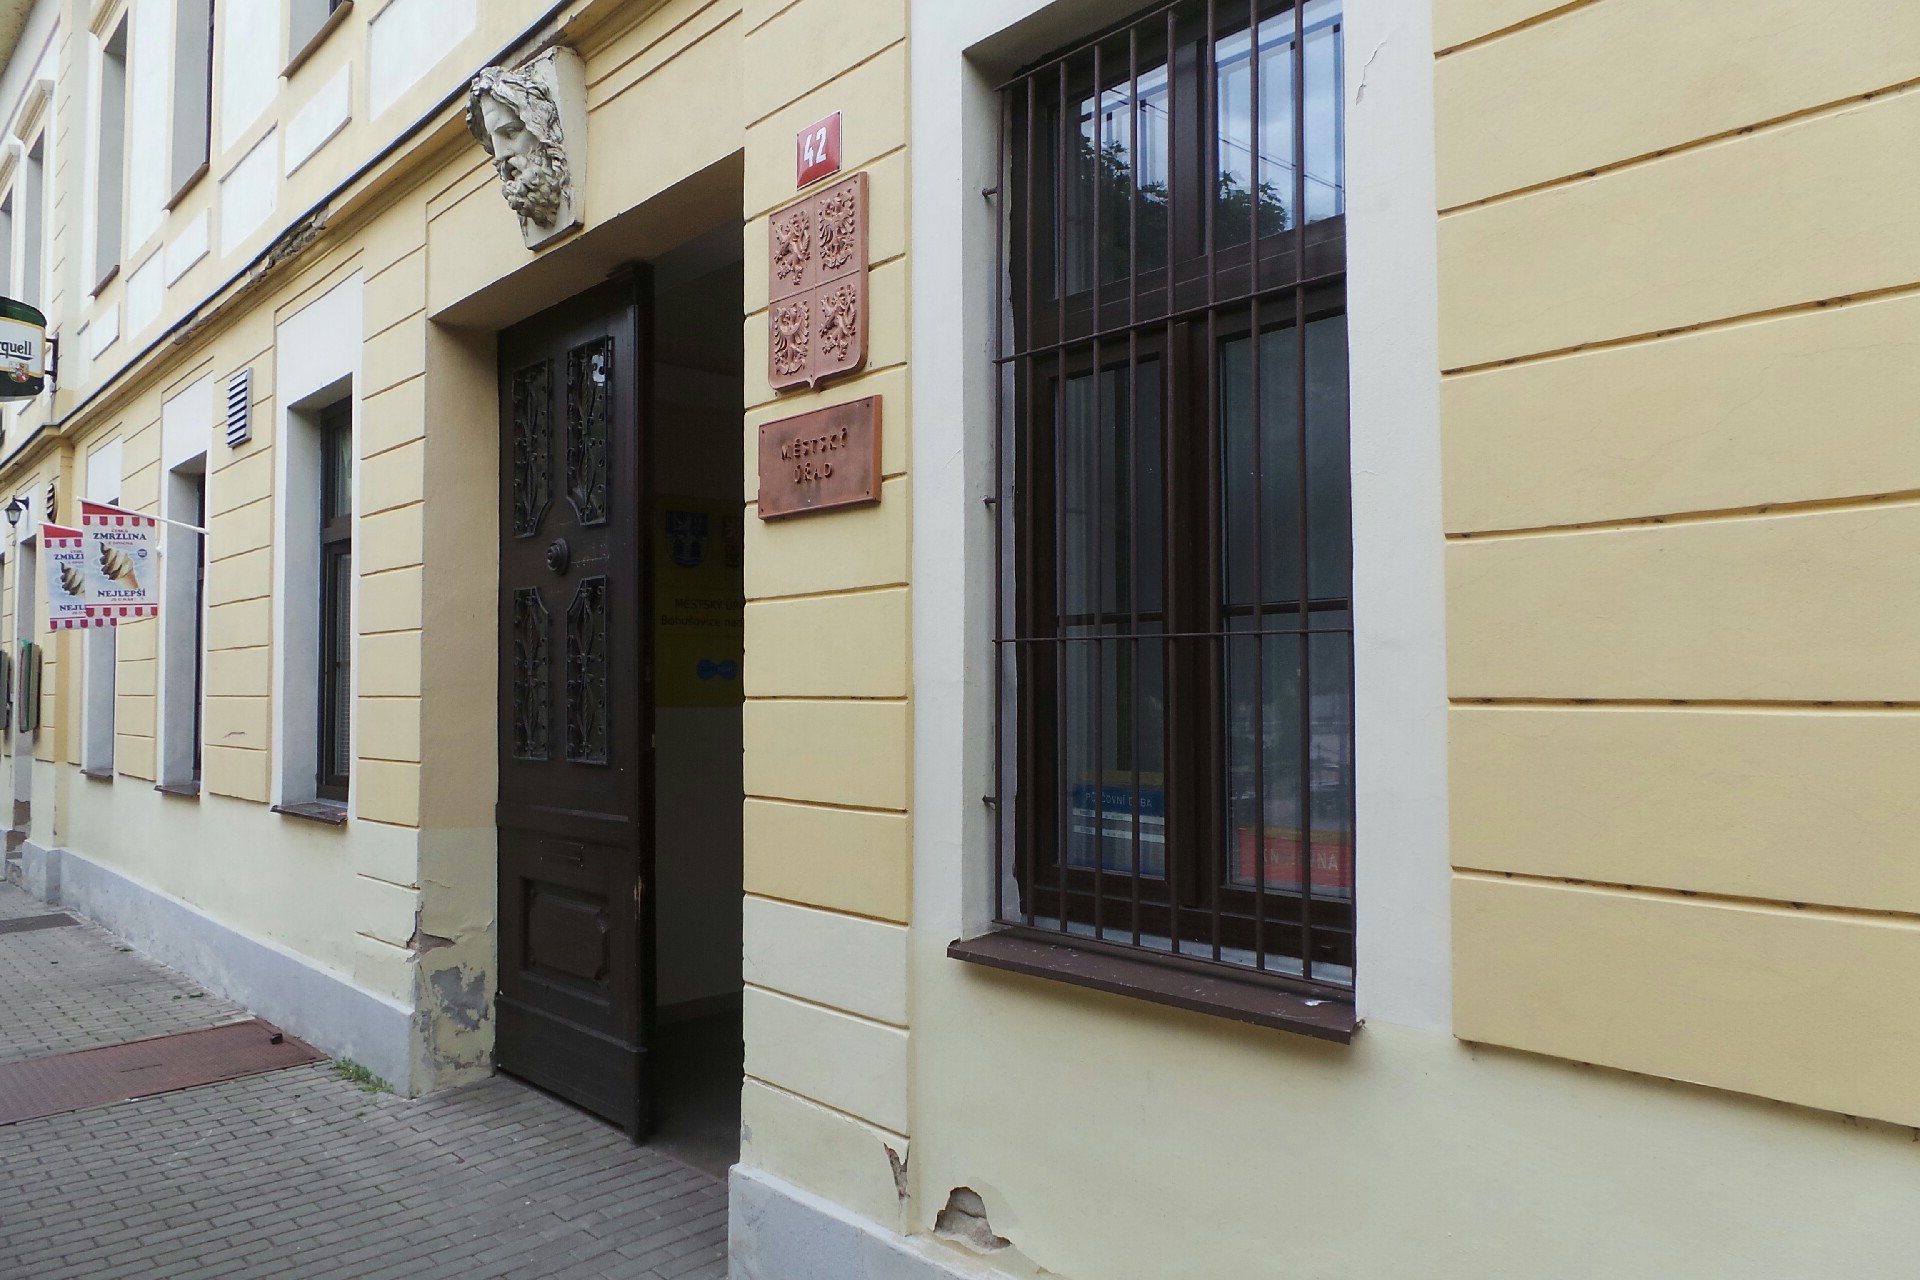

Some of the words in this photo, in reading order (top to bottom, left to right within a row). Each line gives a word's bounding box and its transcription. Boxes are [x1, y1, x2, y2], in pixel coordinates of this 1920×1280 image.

[803, 126, 827, 168] 42
[781, 426, 848, 461] MĚSTSKÝ
[794, 462, 833, 484] ÚŘAD
[92, 532, 147, 541] ZMRZLINA
[97, 588, 146, 598] NEJLEPŠÍ
